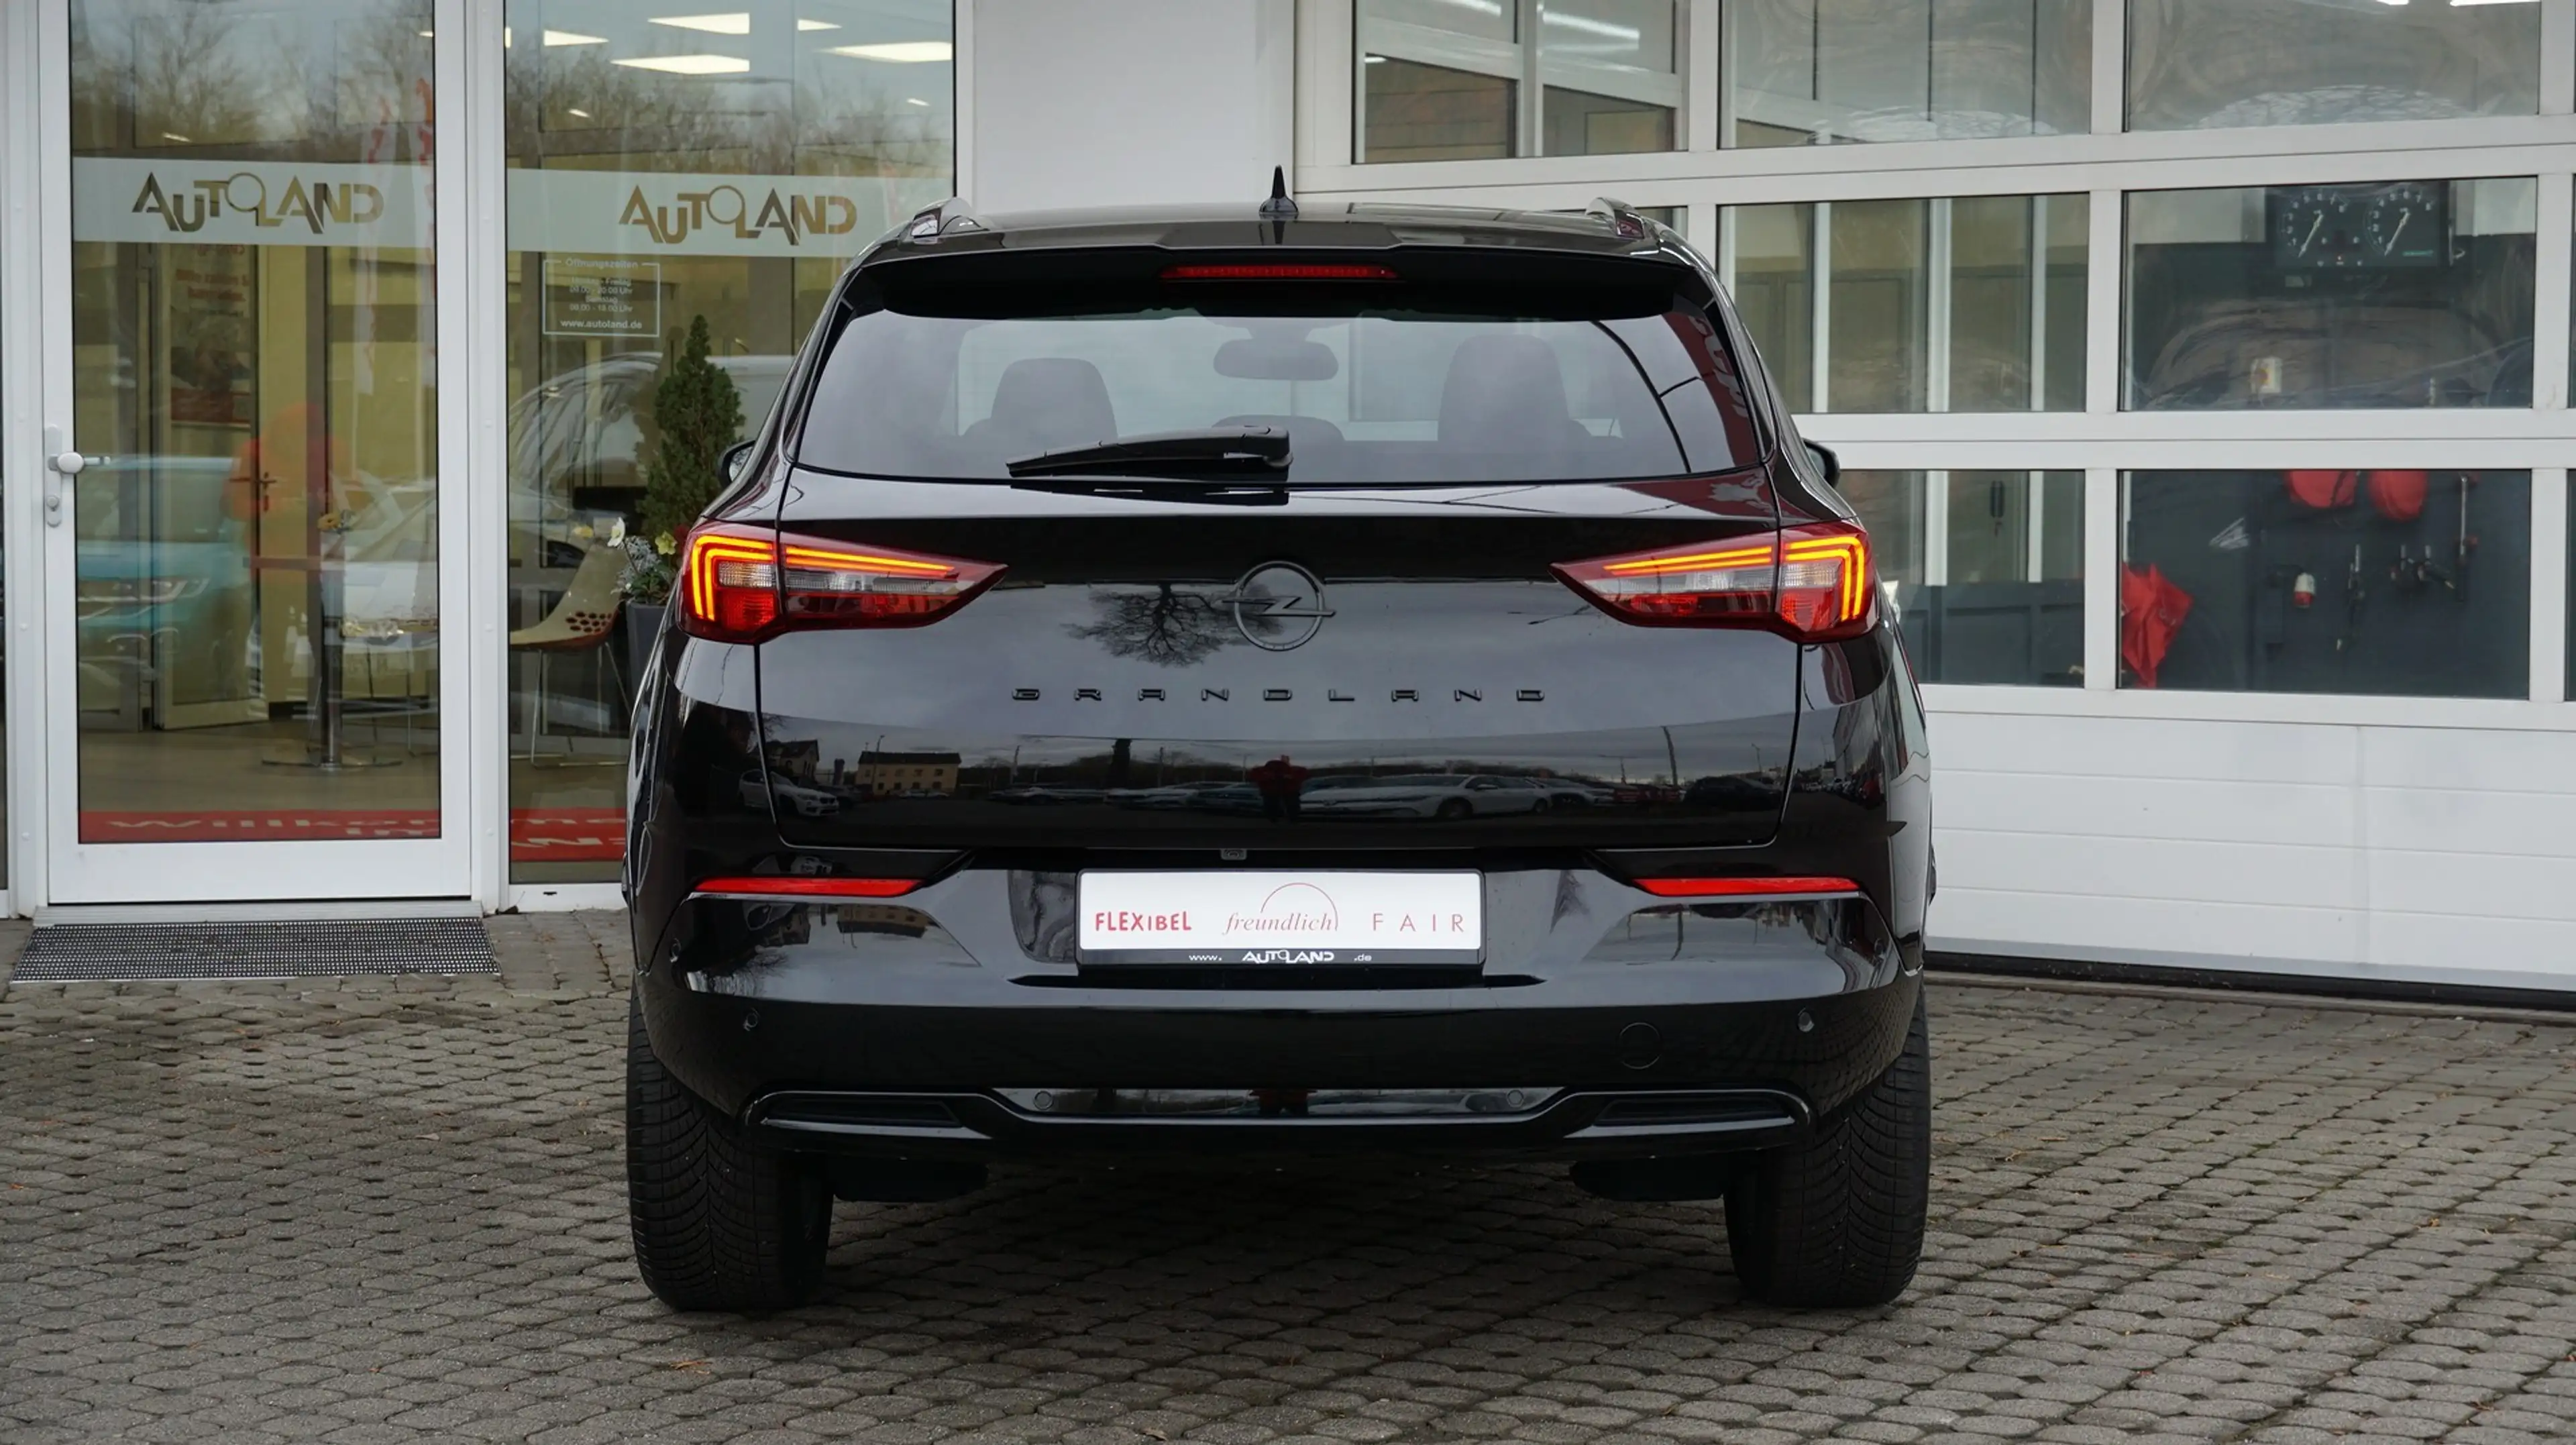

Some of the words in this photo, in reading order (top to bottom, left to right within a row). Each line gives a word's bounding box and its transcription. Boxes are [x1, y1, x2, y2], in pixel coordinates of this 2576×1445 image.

[132, 172, 384, 234] AUTOLAND
[619, 184, 857, 246] AUTOLAND
[566, 257, 639, 270] Öffnungszeiten
[559, 319, 643, 329] www.autoland.de
[1012, 688, 1545, 702] GRANDLAND
[1094, 910, 1192, 932] FLEXIBEL
[1222, 912, 1333, 936] freundlich
[1372, 913, 1465, 933] FAIR
[1242, 949, 1335, 964] AUTOLAND
